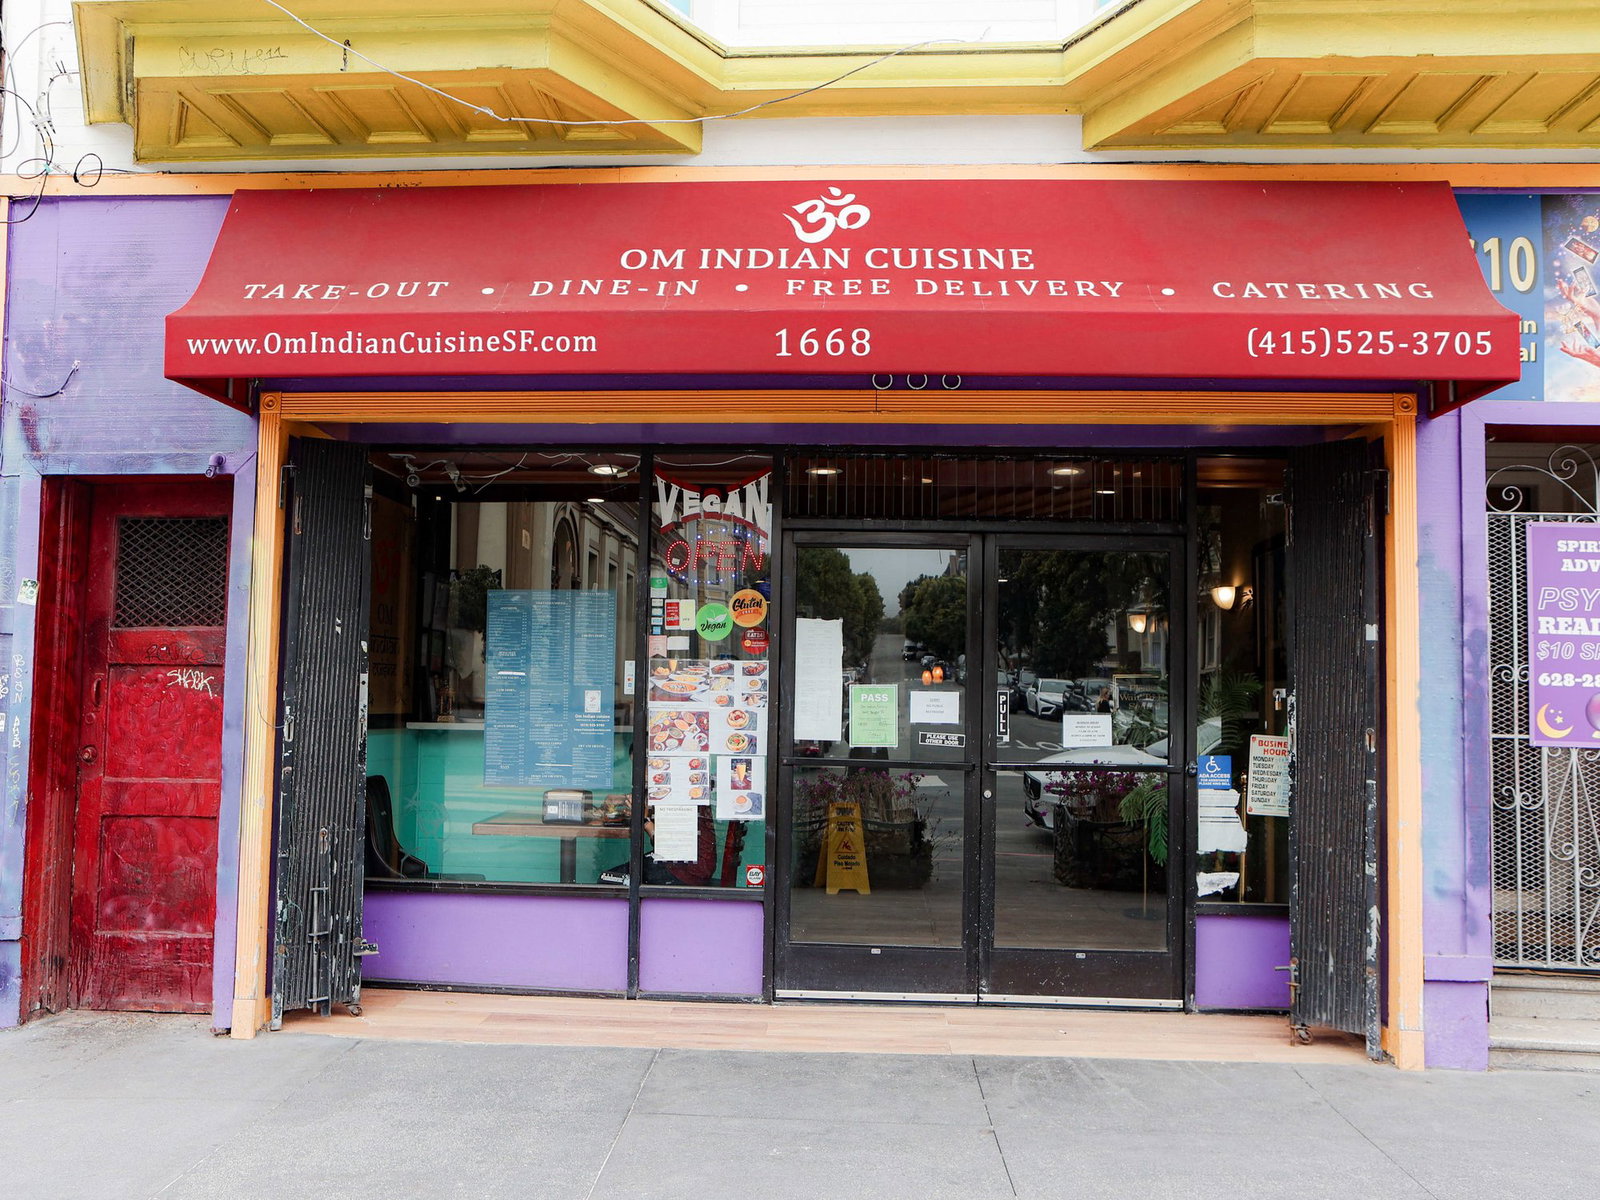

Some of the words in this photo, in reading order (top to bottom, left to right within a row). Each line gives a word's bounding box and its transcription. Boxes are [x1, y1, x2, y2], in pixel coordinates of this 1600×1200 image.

[620, 248, 686, 270] OM
[699, 247, 851, 271] INDIAN
[864, 247, 1035, 271] CUISINE
[1470, 236, 1535, 292] 10
[242, 281, 450, 300] TAKE-OUT
[529, 279, 700, 297] DINE-IN
[785, 279, 891, 297] FREE
[915, 279, 1124, 297] DELIVERY
[1212, 281, 1435, 300] CATERING
[187, 329, 598, 355] www.OmIndianCuisineSF.com
[776, 328, 871, 357] 1668
[1247, 327, 1492, 358] (415)525-3705
[655, 471, 772, 540] VEGAN
[667, 540, 765, 571] OPEN
[732, 597, 763, 612] Gluten
[700, 620, 727, 632] Vegan
[1536, 640, 1575, 661] $10
[1538, 672, 1600, 688] 628-2
[861, 693, 889, 702] PASS
[1252, 776, 1277, 784] THURSDAY
